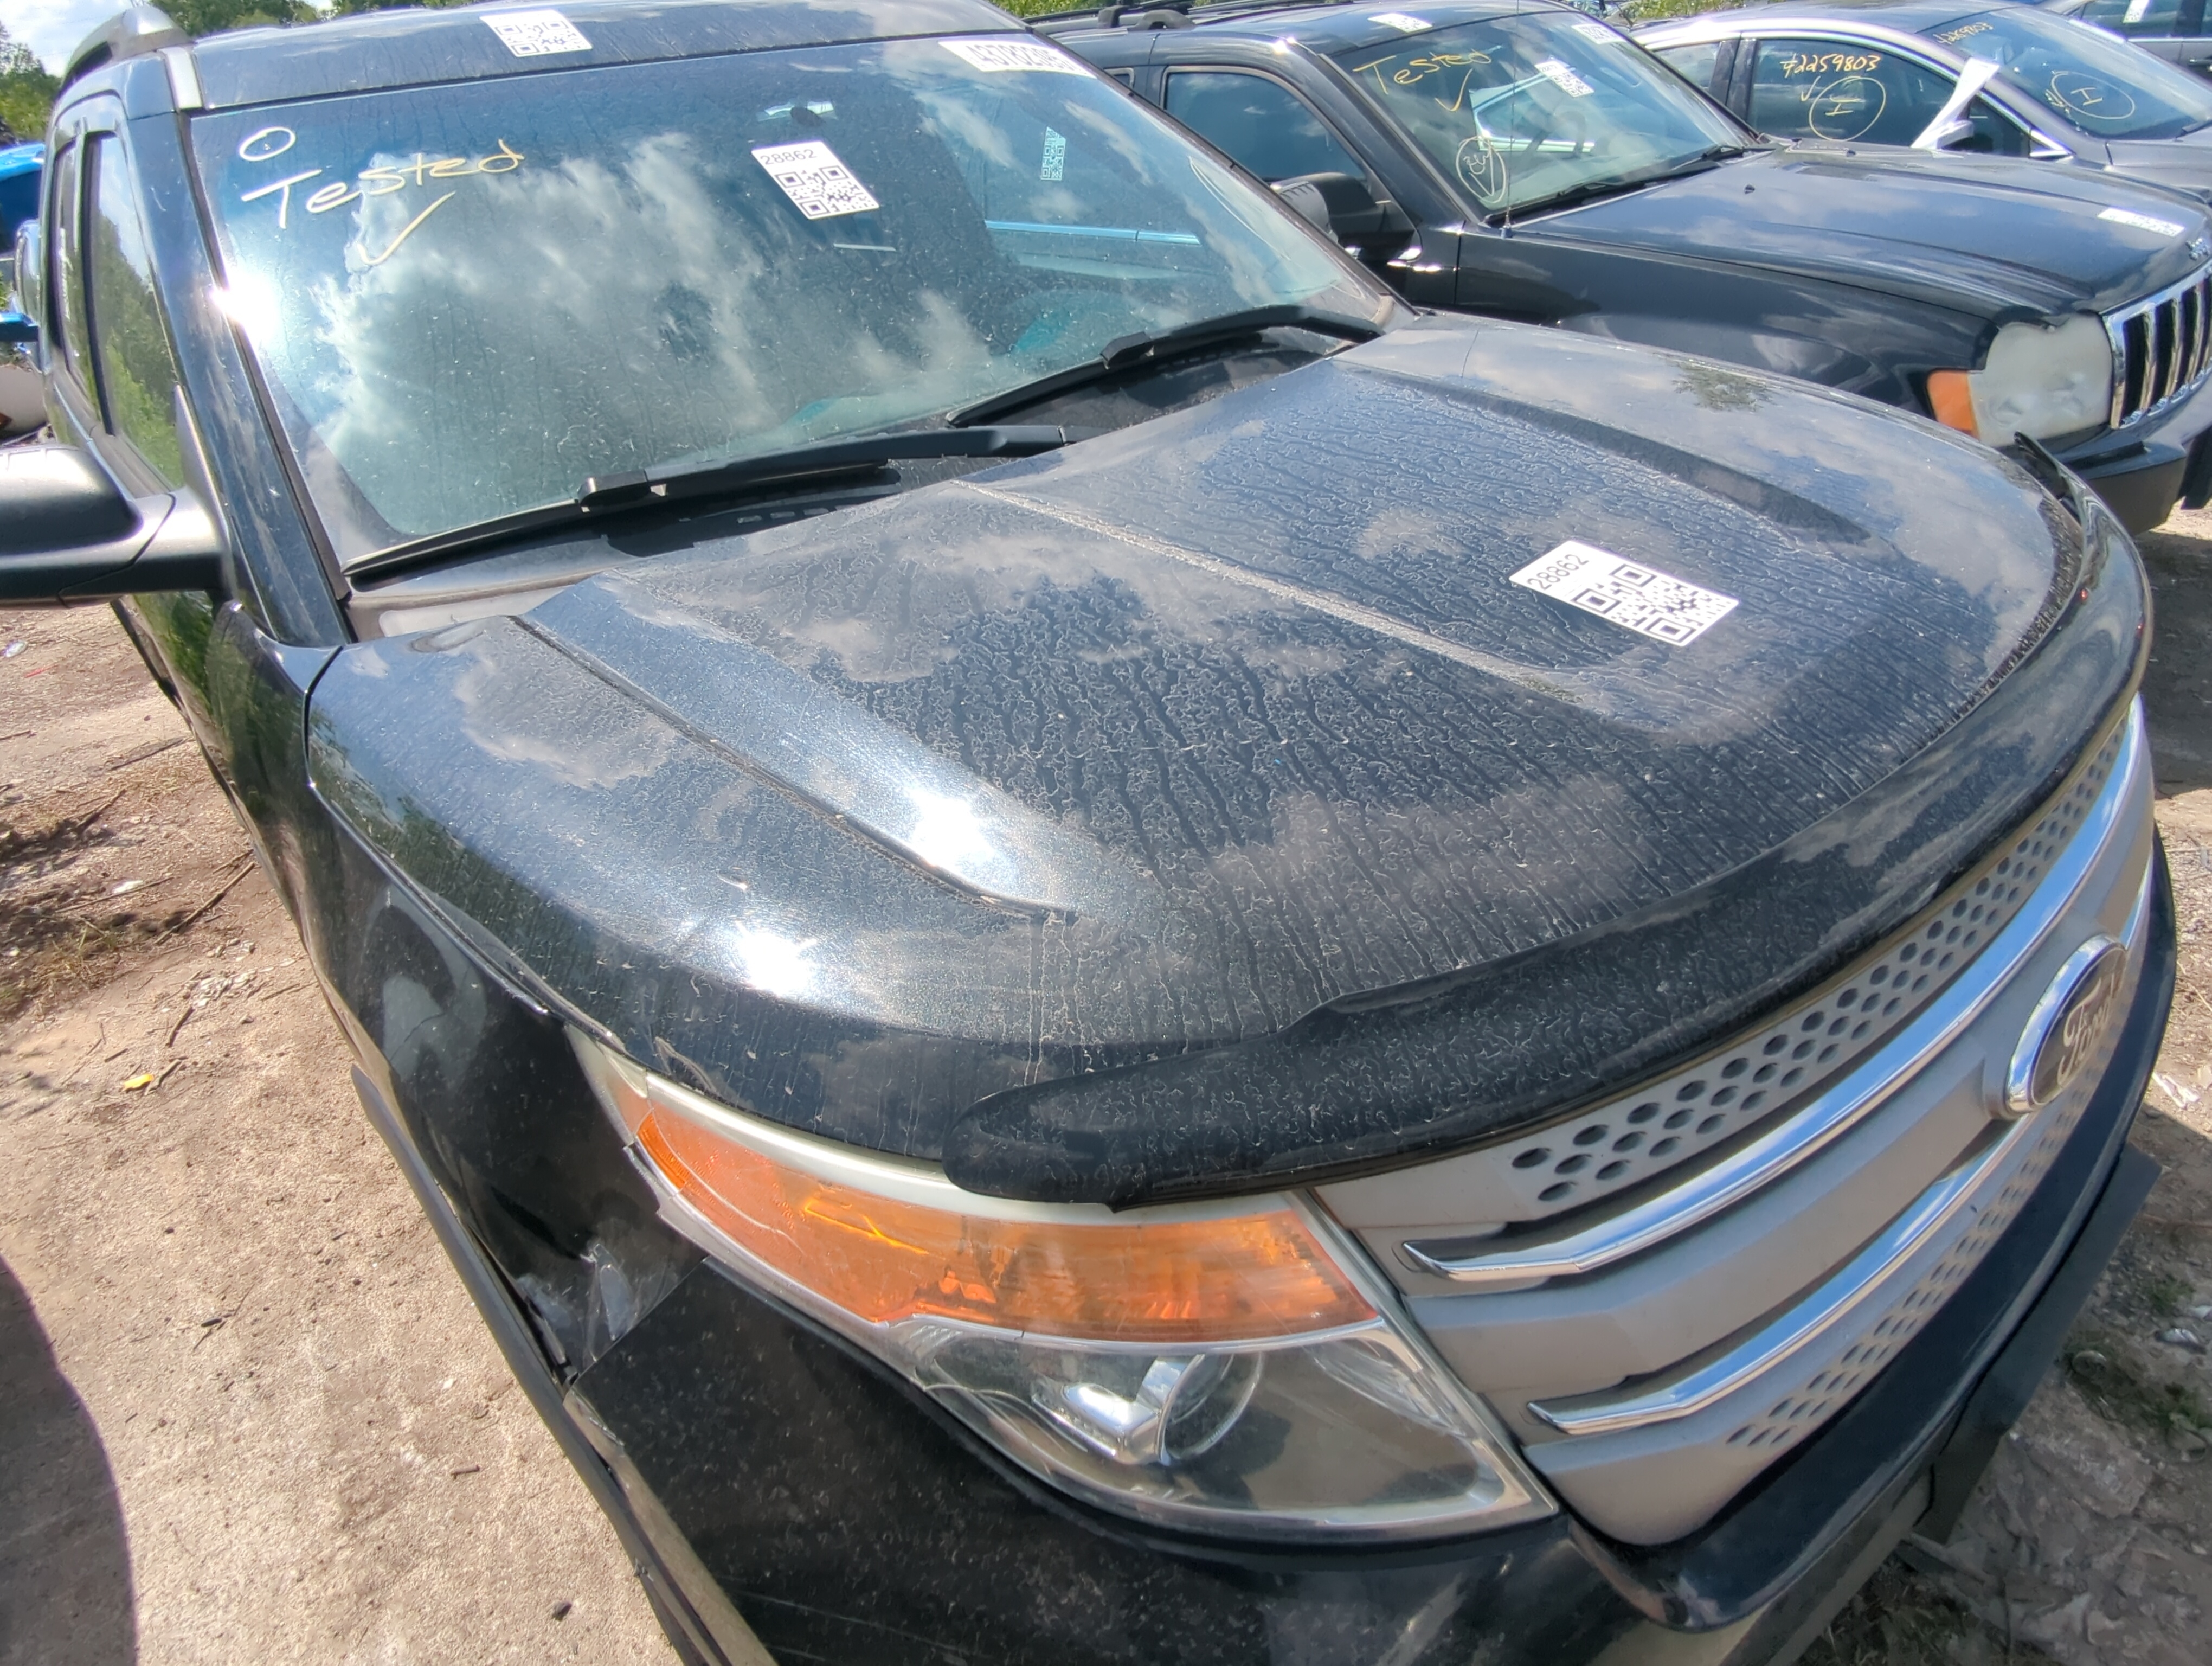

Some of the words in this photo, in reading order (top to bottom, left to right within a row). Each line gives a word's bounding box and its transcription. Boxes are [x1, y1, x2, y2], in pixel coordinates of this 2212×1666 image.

[241, 139, 525, 229] Tested
[760, 148, 818, 165] 28862
[1526, 553, 1590, 591] 28862
[2057, 972, 2115, 1086] Ford
